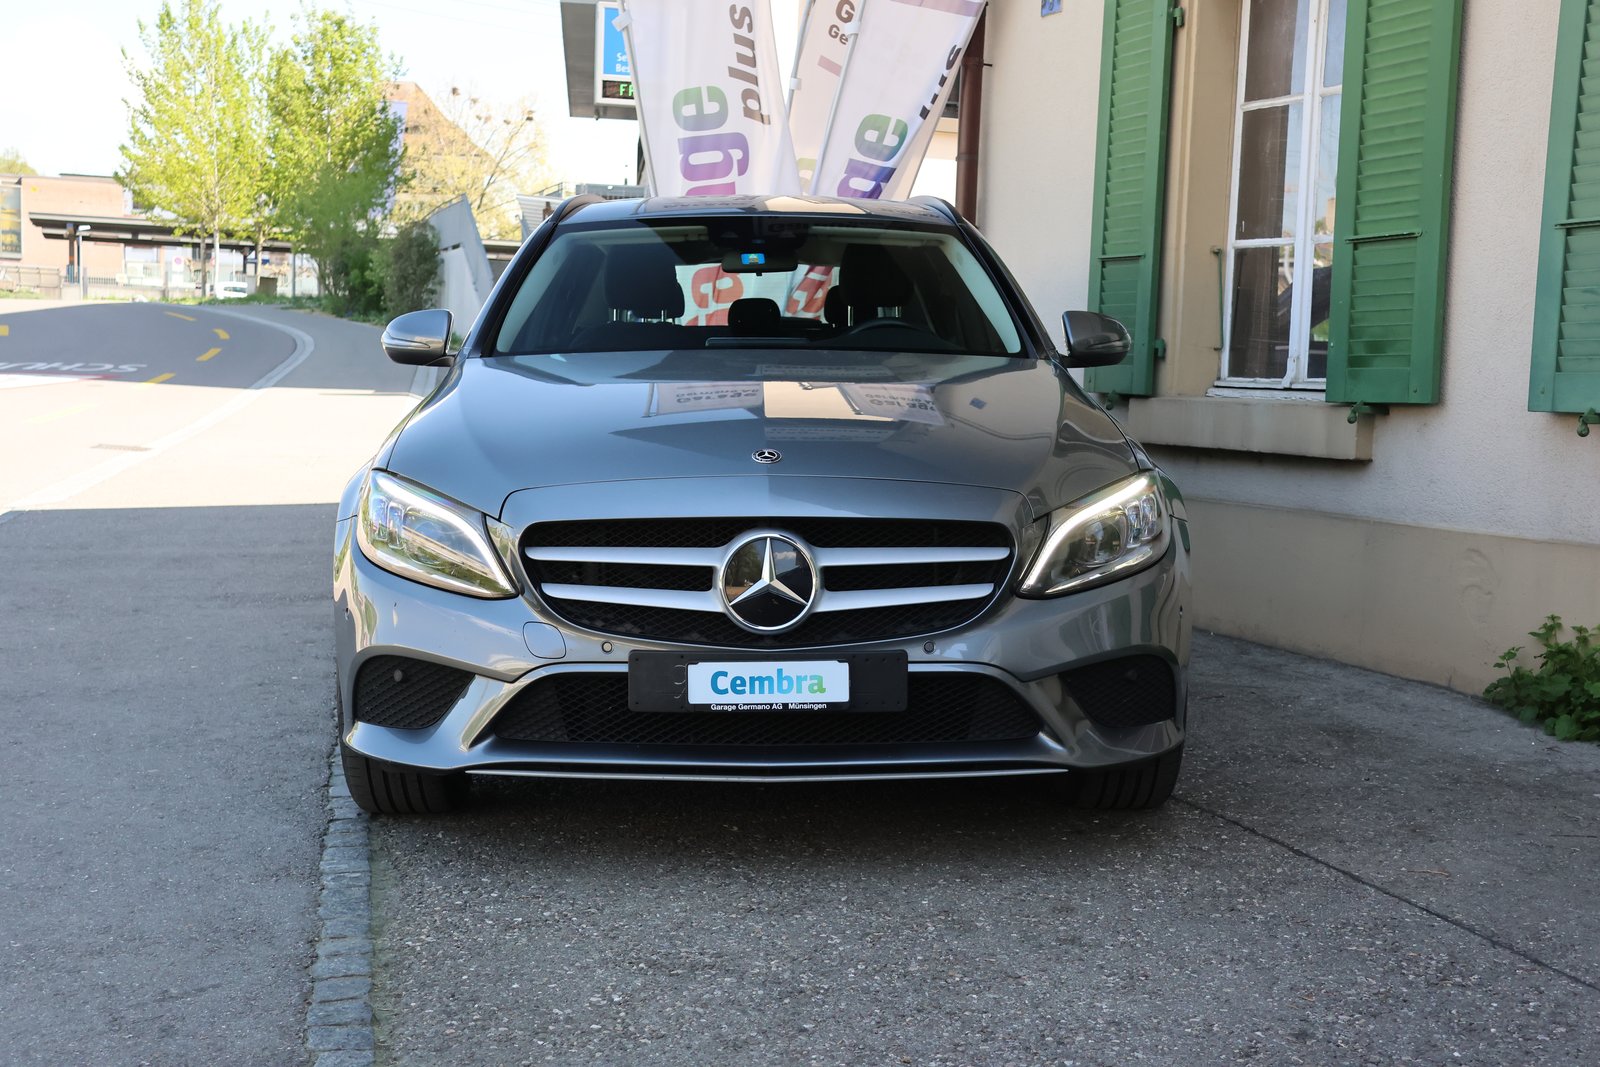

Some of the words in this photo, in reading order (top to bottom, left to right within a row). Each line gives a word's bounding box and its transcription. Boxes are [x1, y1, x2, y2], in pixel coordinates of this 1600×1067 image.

[728, 3, 770, 125] plus
[710, 668, 827, 695] Cembra
[710, 703, 737, 712] Garage
[738, 703, 771, 711] Germano
[788, 702, 827, 711] Münsingen
